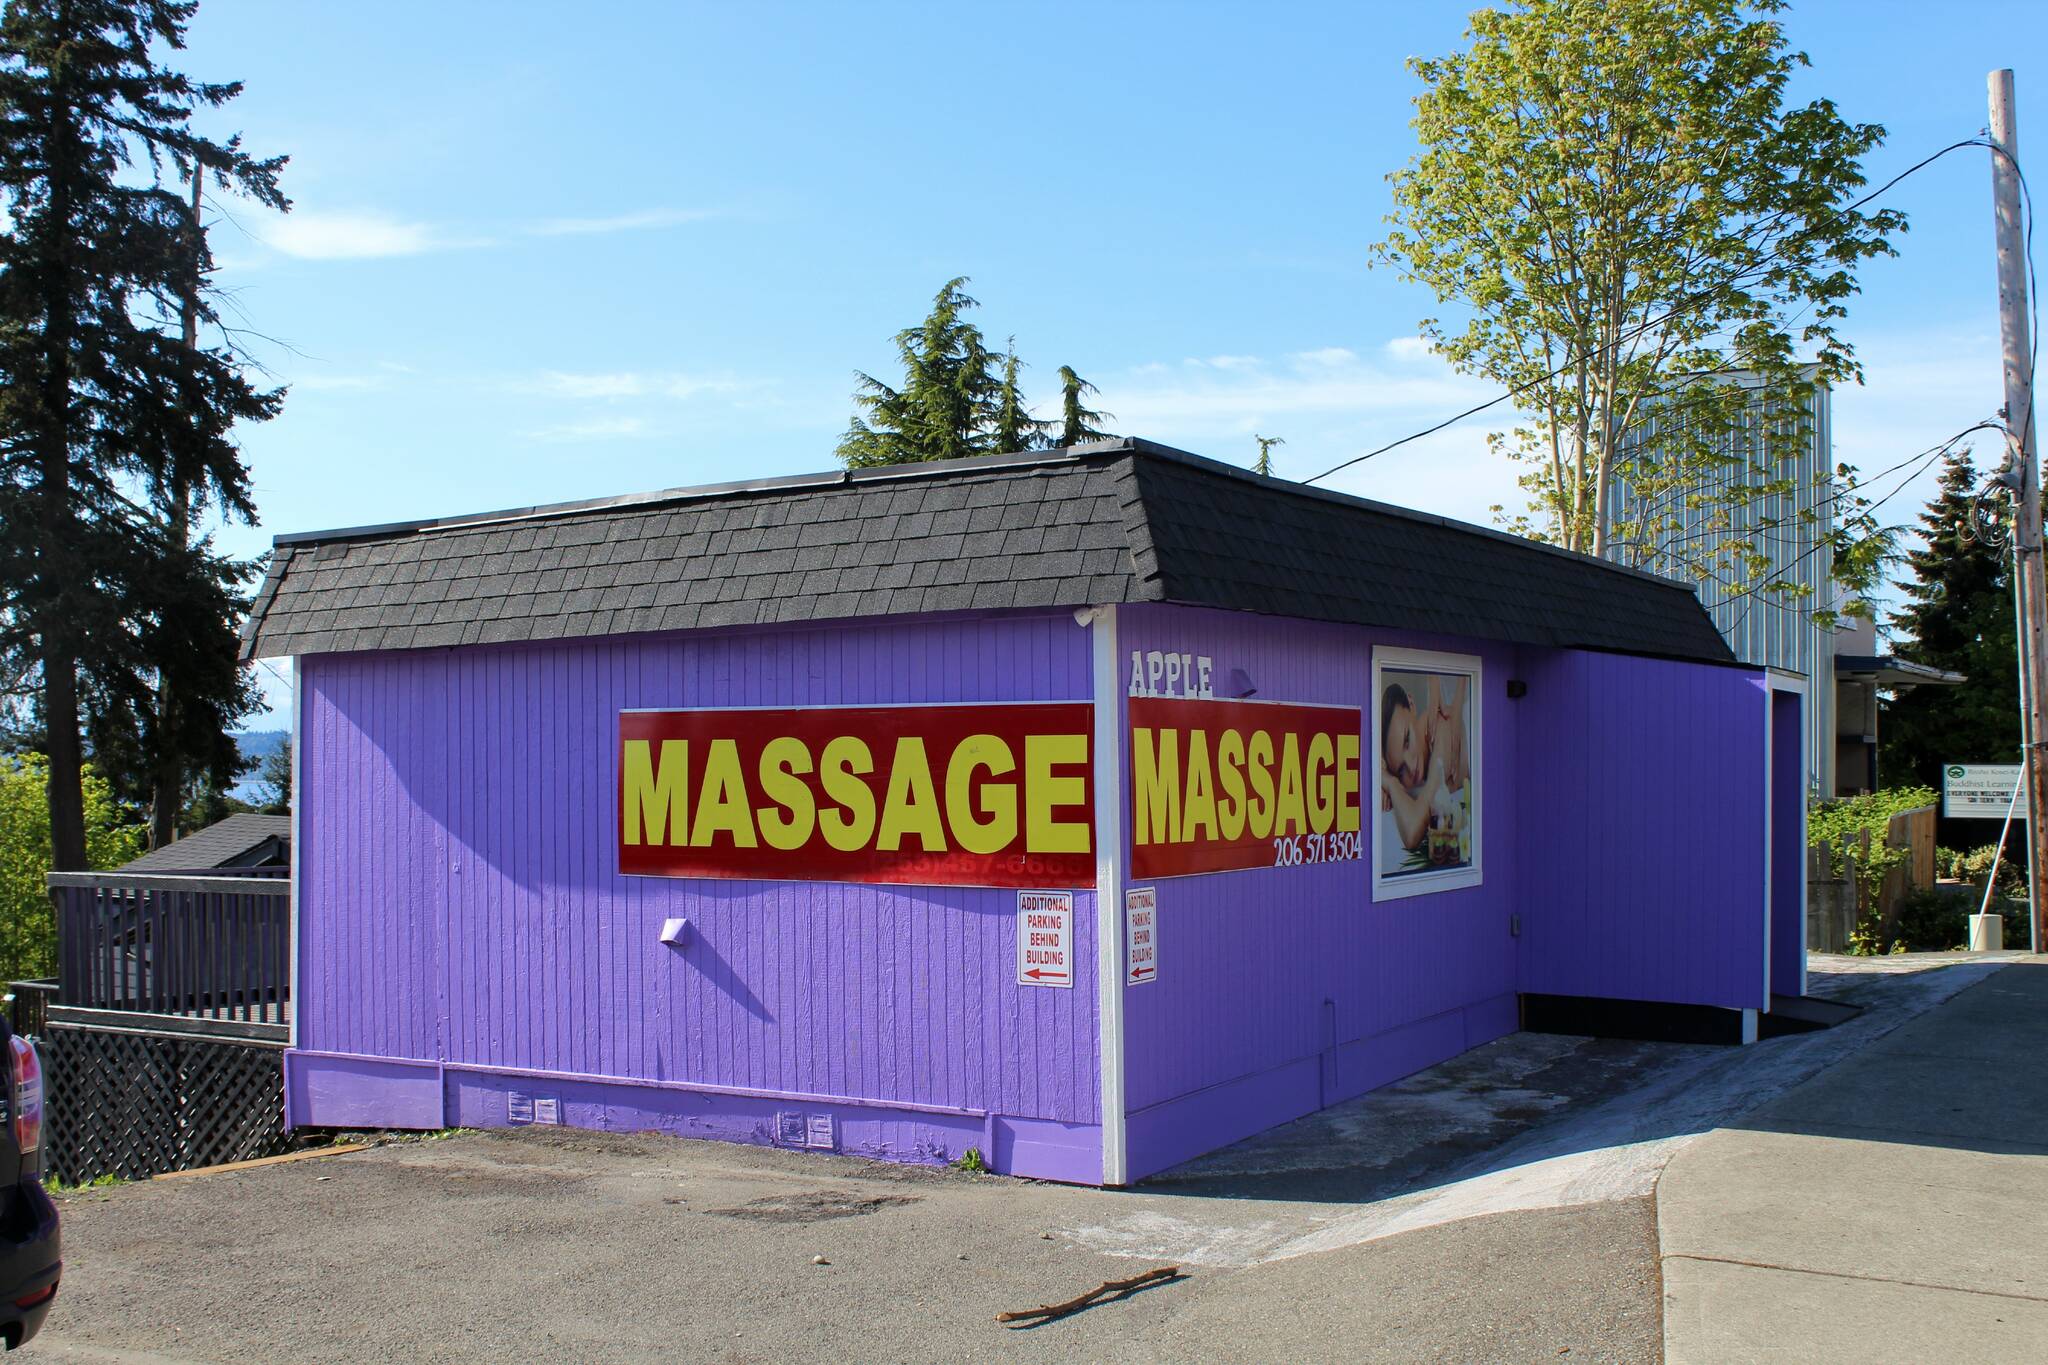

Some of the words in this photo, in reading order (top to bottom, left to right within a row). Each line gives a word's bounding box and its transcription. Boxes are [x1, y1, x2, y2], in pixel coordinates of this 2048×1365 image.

[1128, 650, 1213, 700] APPLE
[623, 734, 1091, 854] MASSAGE
[1133, 727, 1360, 846] MASSAGE
[1274, 835, 1303, 867] 206
[1306, 833, 1327, 865] 571
[1328, 829, 1363, 862] 3504
[1021, 896, 1068, 912] ADDITIONAL
[1128, 893, 1154, 910] ADDITIONAL
[1027, 914, 1062, 930] PARKING
[1132, 911, 1151, 927] PARKING
[1030, 932, 1059, 948] BEHIND
[1134, 929, 1150, 945] BEHIND
[1026, 950, 1064, 966] BUILDING
[1132, 946, 1152, 963] BUILDING
